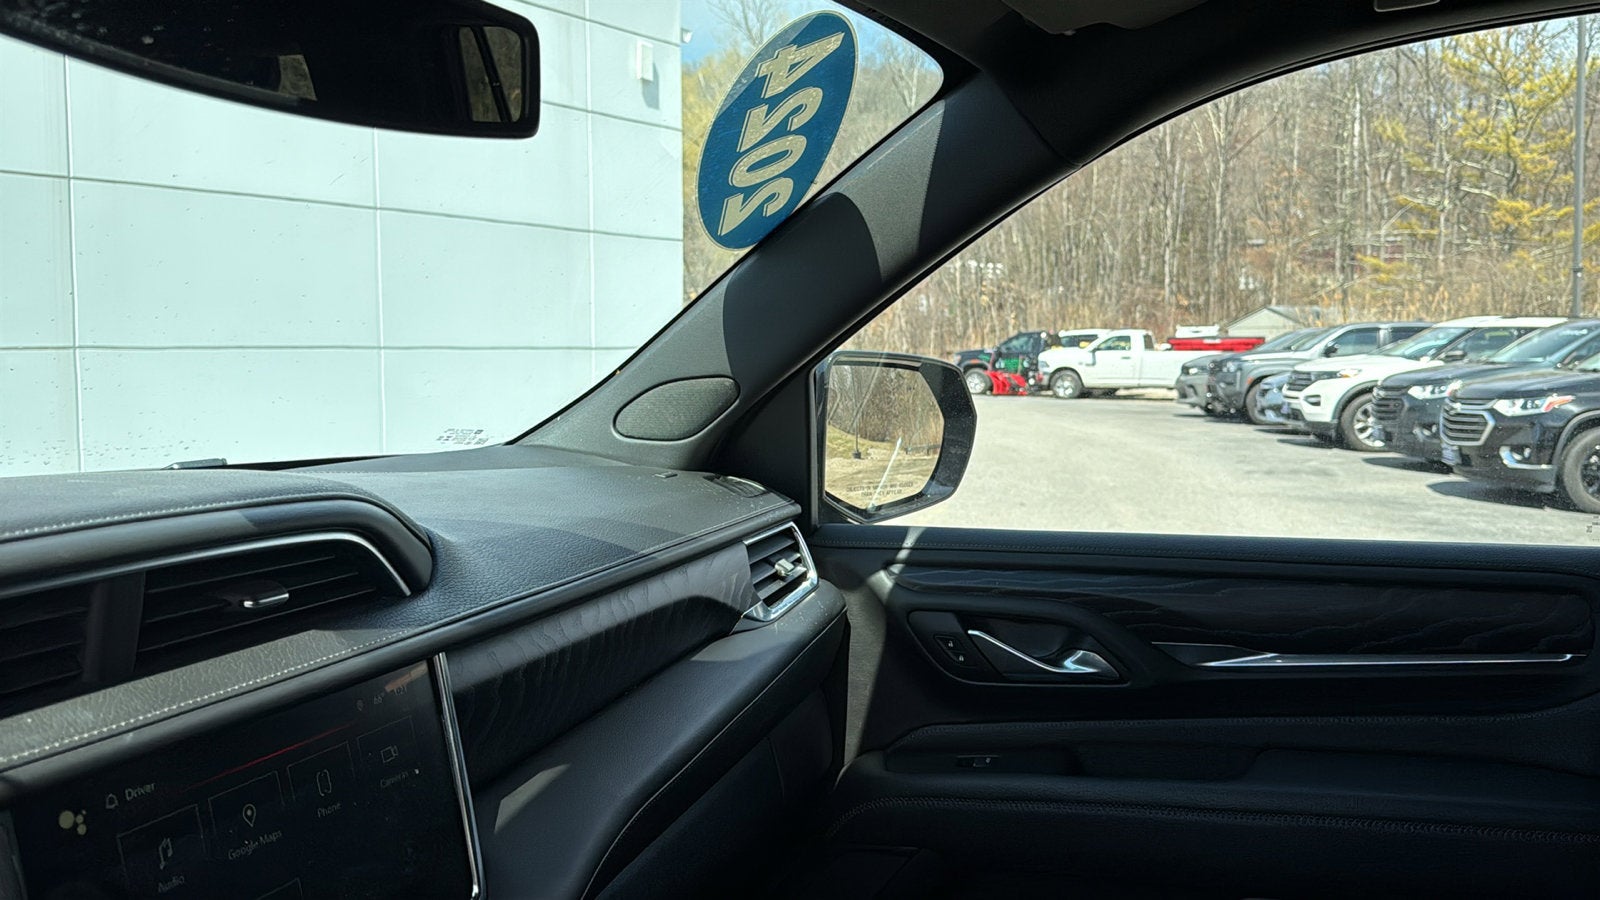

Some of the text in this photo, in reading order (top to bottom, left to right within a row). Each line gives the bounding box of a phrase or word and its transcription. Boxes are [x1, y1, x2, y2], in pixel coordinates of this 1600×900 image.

[125, 783, 157, 802] Driver
[317, 801, 343, 818] Phone
[228, 830, 283, 861] Google Maps
[158, 874, 186, 894] Audio
